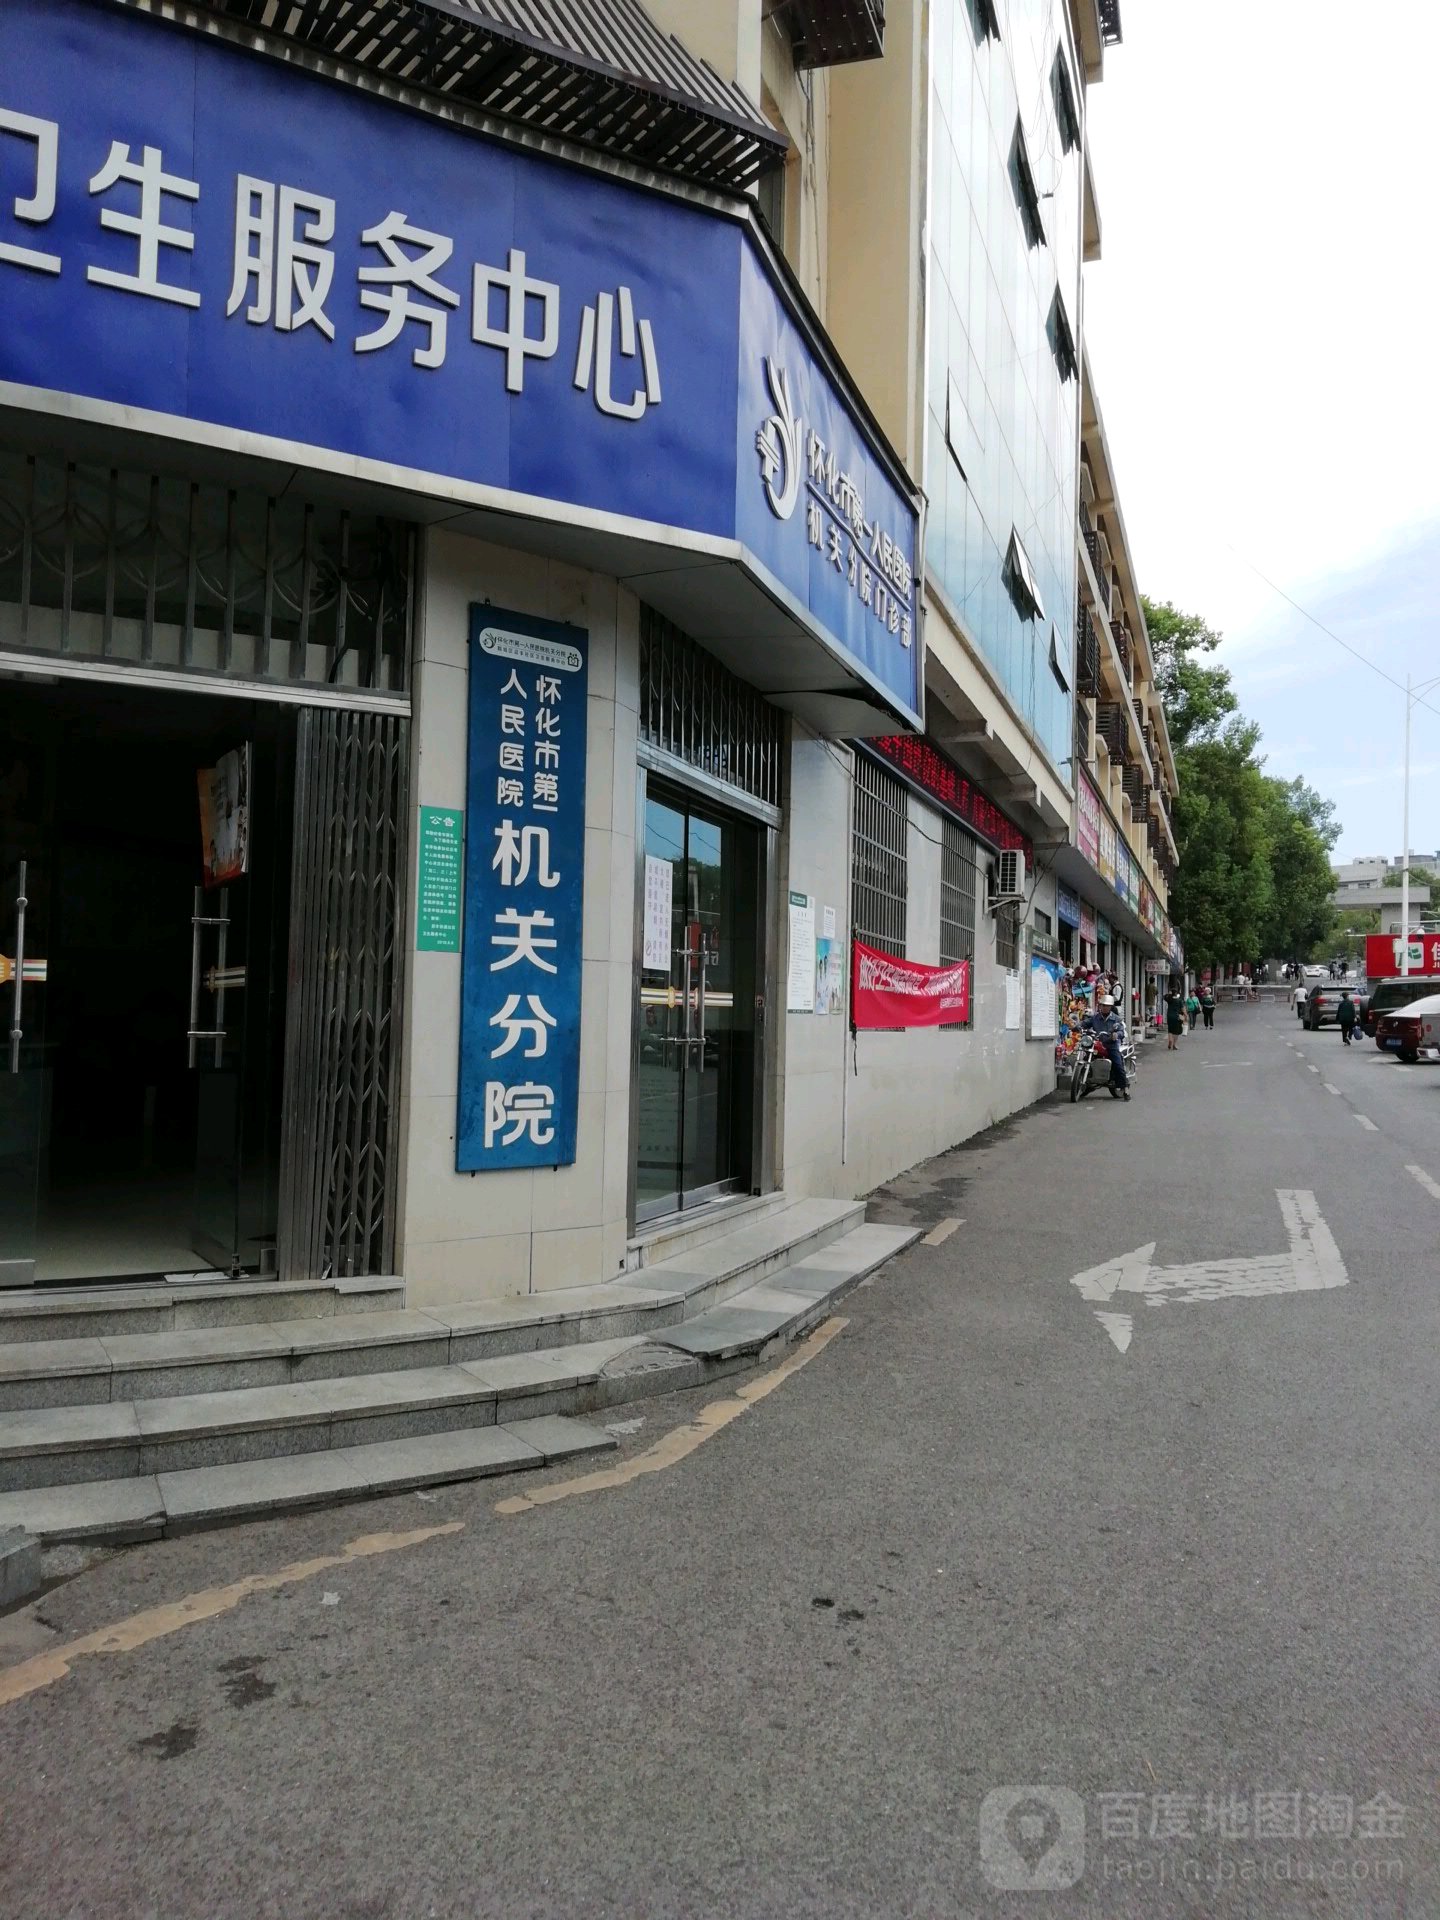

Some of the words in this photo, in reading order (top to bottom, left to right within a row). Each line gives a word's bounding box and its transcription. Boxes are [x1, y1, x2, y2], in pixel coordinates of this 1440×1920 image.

[807, 428, 912, 600] 怀化市第一人民医院
[807, 501, 912, 649] 机关分院门诊部
[496, 667, 527, 807] 人民医院
[532, 674, 562, 812] 怀化市第一
[429, 815, 456, 827] 公告
[484, 818, 561, 1149] 机关分院
